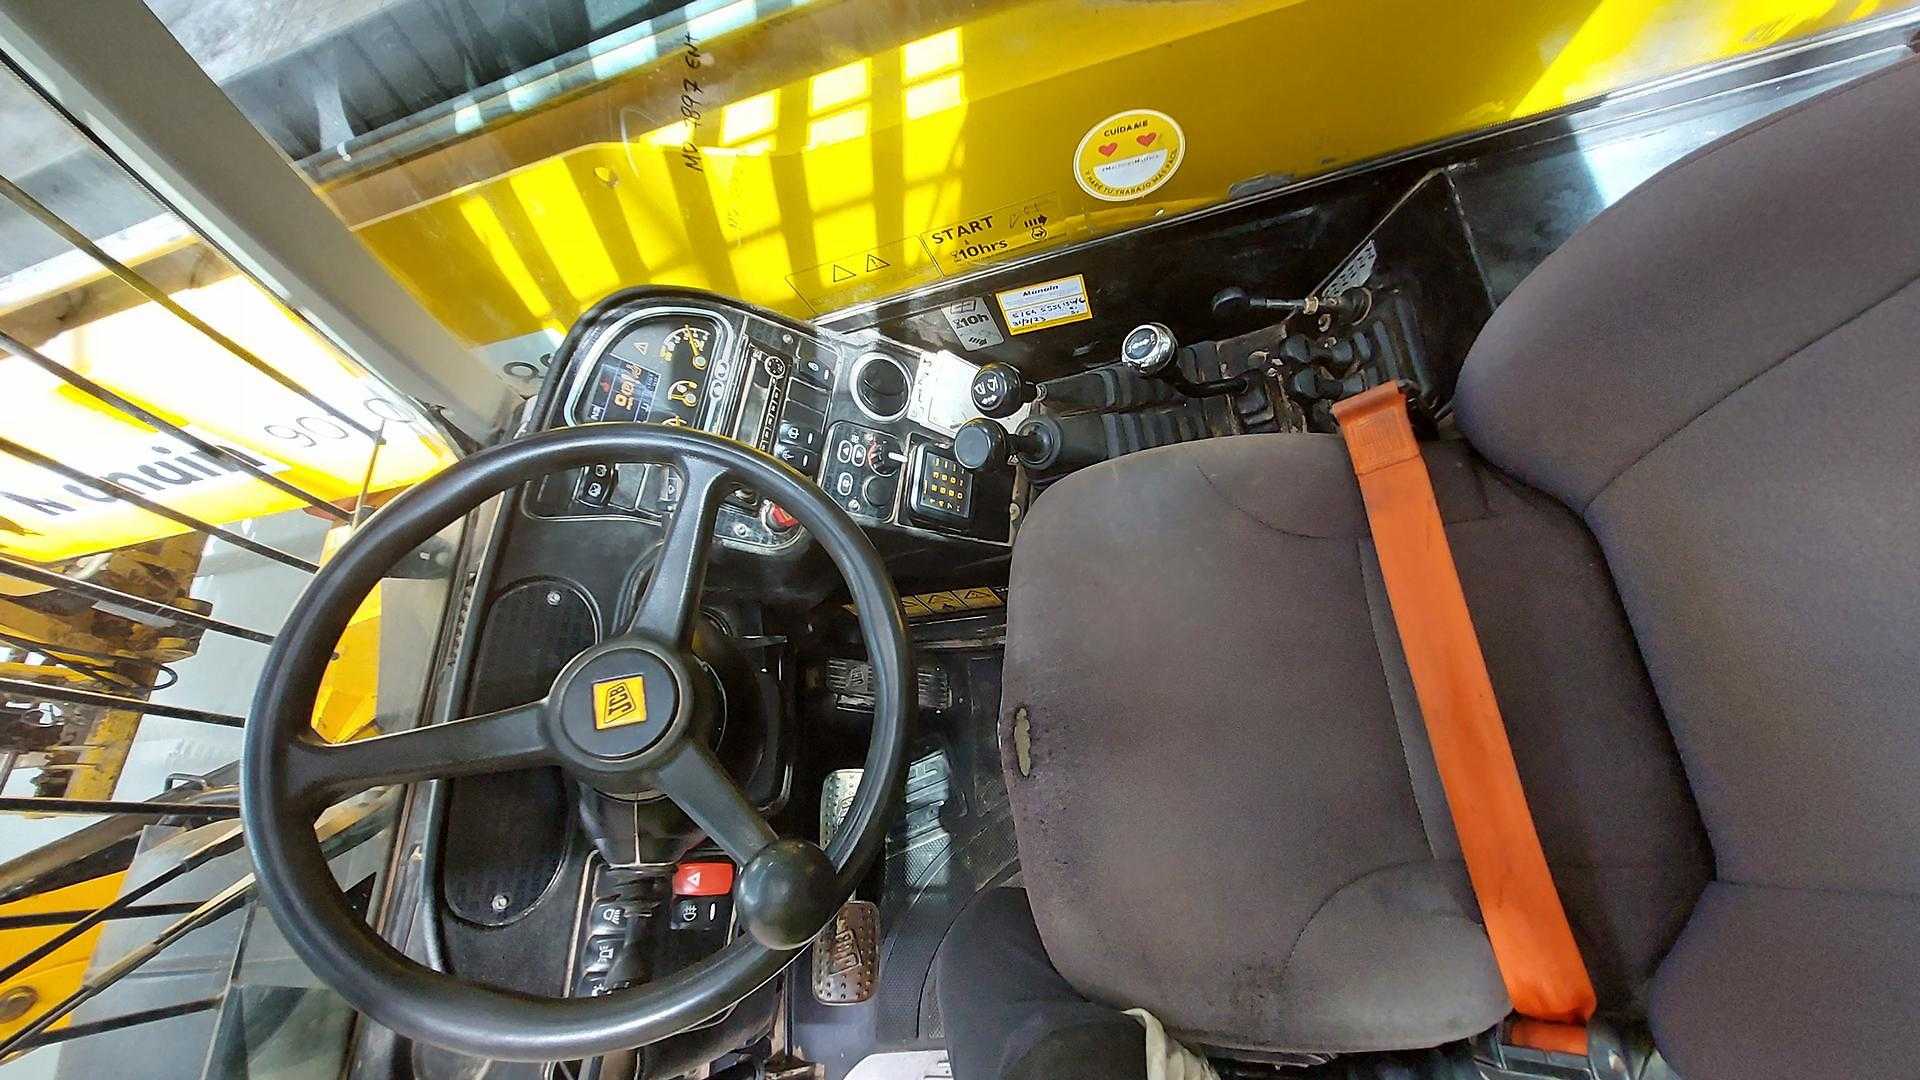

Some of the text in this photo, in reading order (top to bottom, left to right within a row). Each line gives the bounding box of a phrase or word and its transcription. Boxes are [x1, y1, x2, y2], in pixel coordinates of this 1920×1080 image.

[932, 215, 993, 244] START
[959, 239, 1008, 259] 10hrs
[960, 313, 990, 327] 10h
[606, 684, 634, 719] JCB
